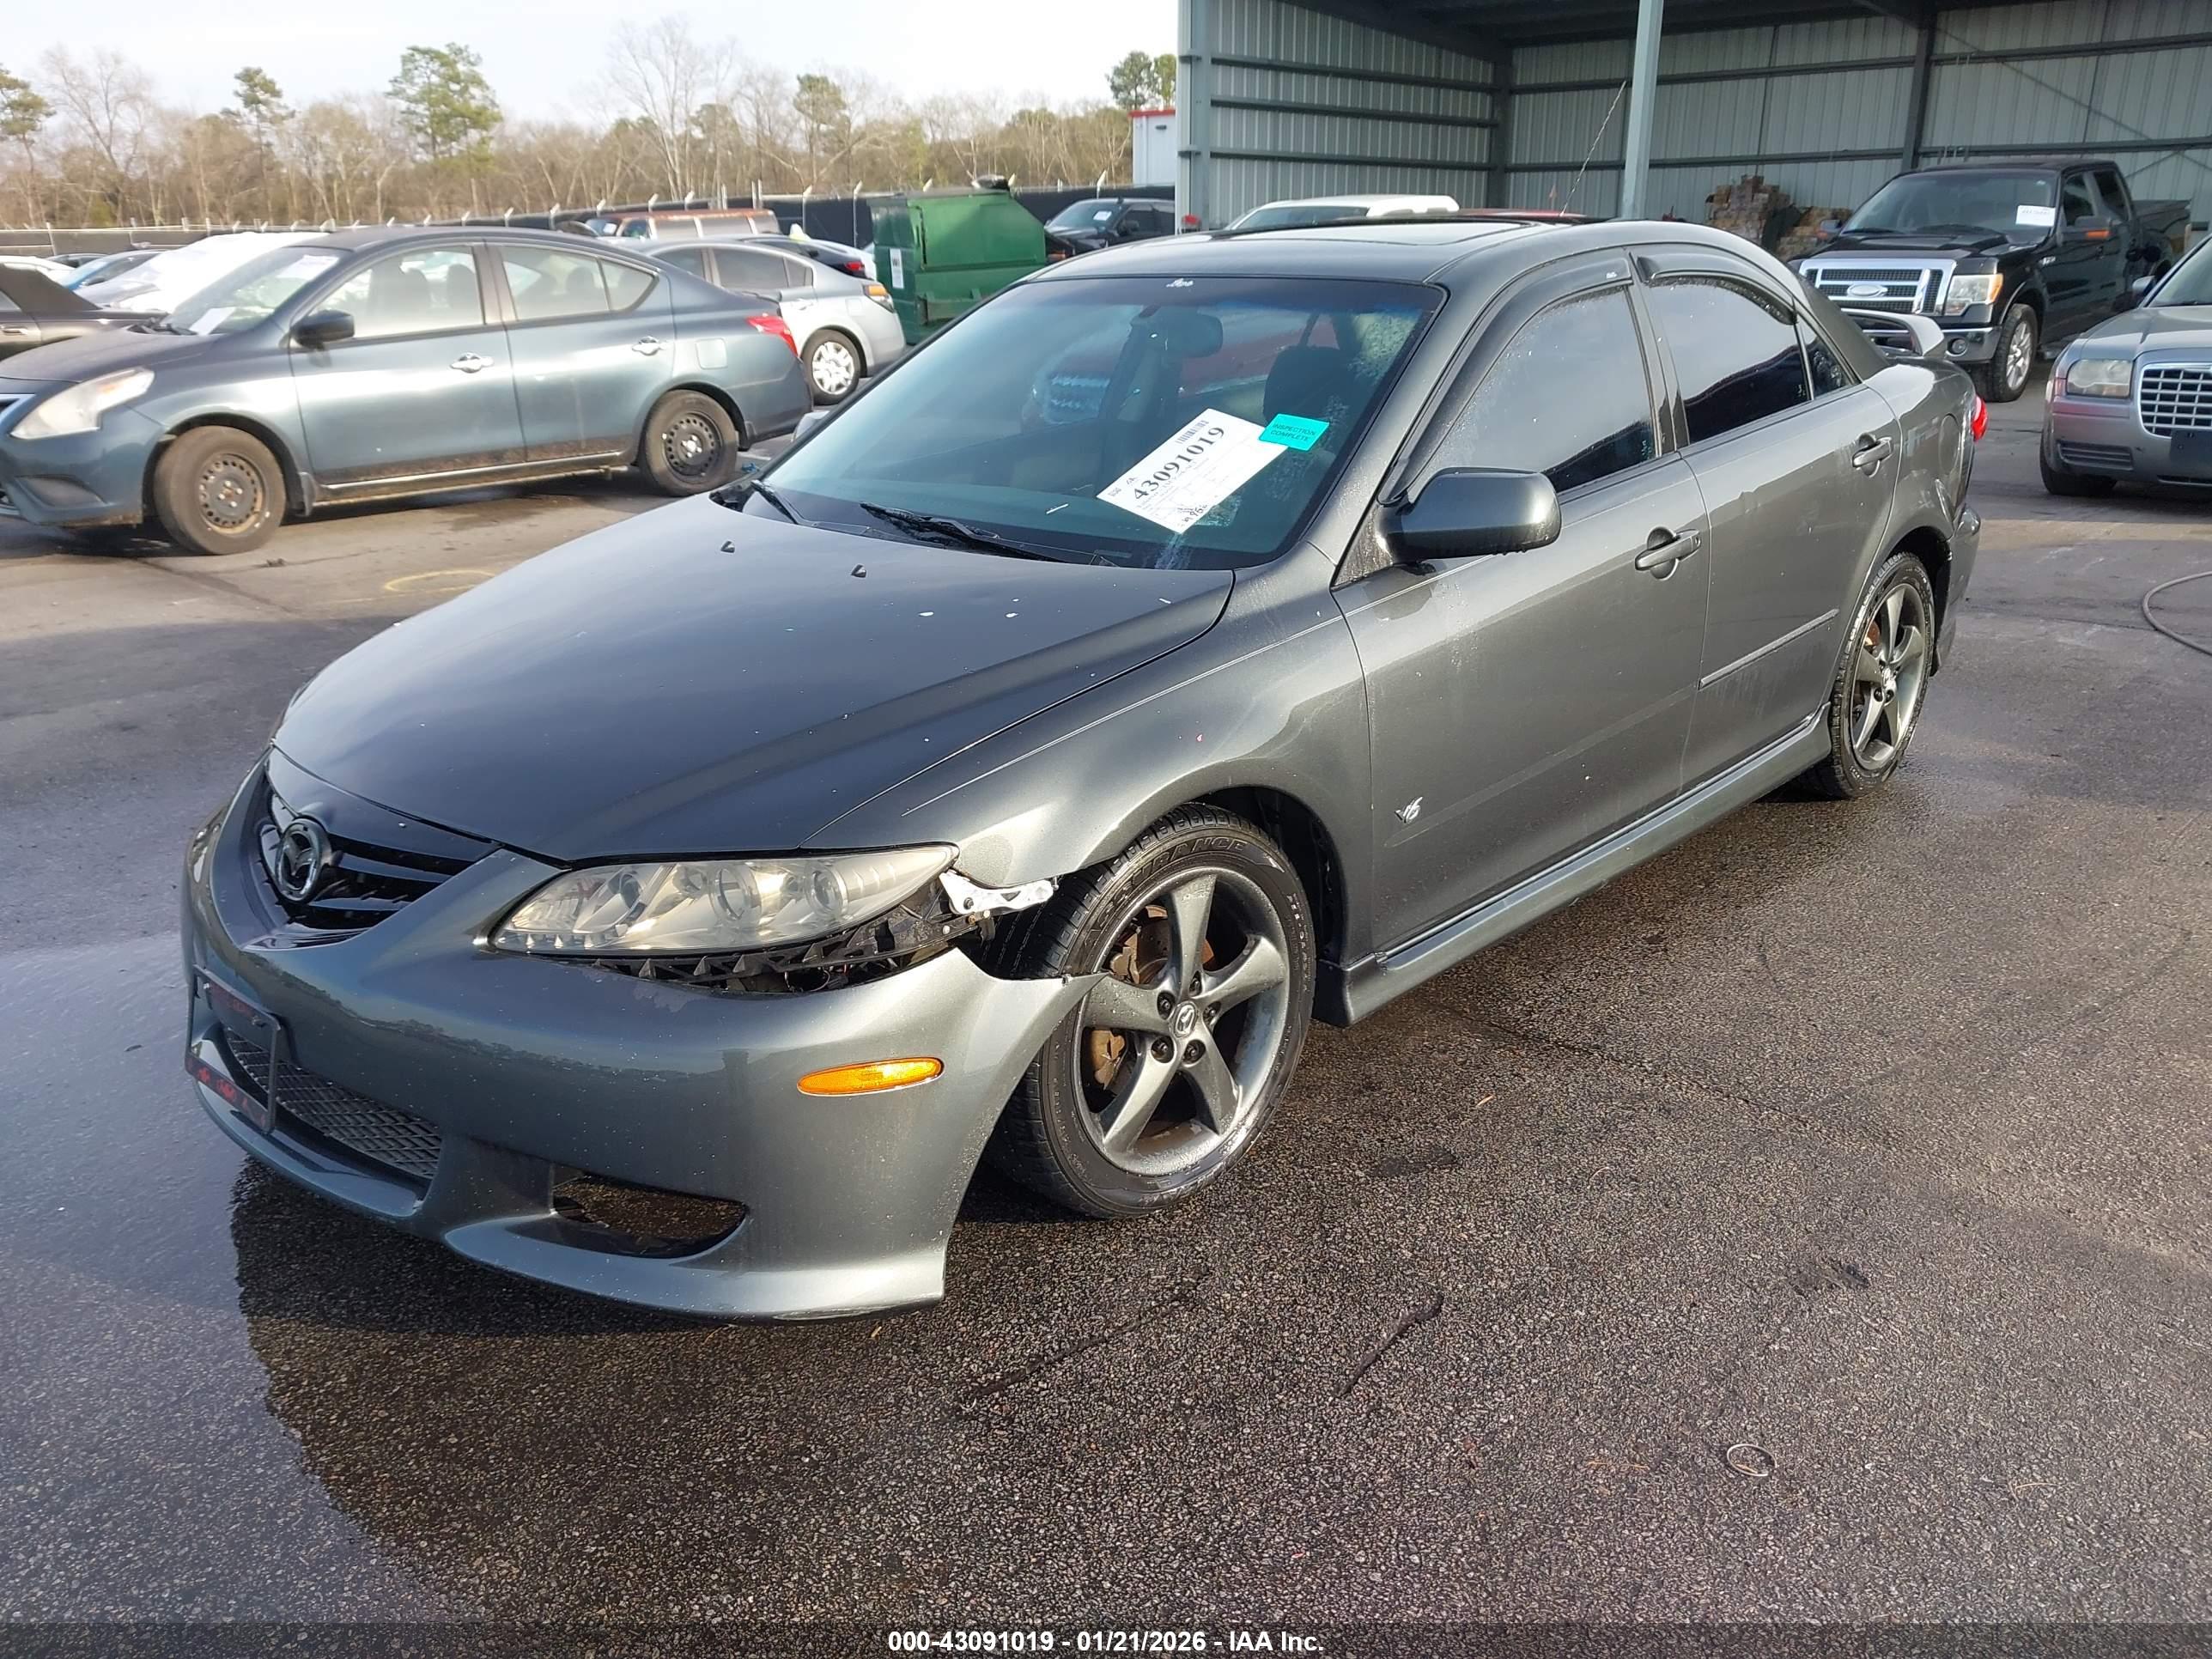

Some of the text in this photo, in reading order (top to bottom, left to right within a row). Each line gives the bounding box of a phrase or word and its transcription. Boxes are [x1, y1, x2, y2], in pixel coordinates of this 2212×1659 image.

[1270, 429, 1310, 441] COMPLETE
[1272, 422, 1316, 436] INSPECTION
[1133, 427, 1224, 500] 43091019
[1084, 836, 1249, 947] ASSURANCE
